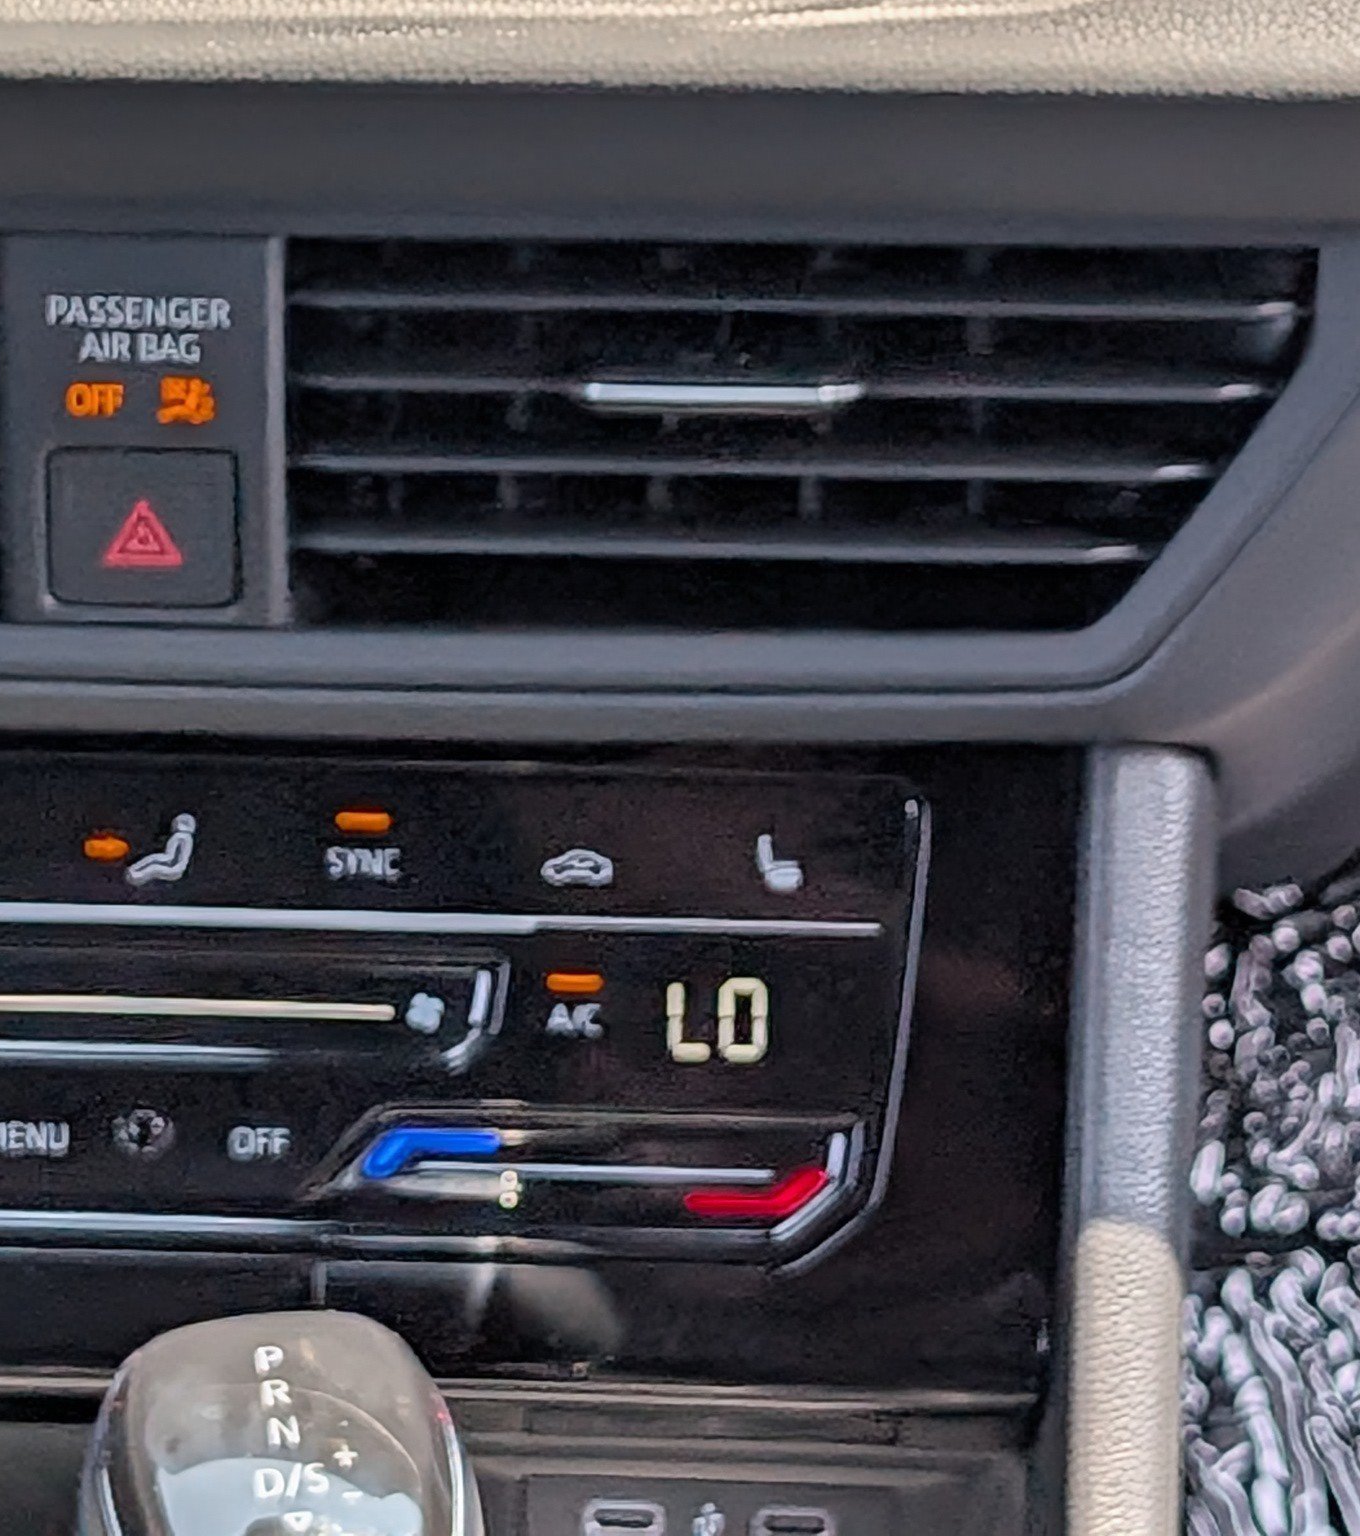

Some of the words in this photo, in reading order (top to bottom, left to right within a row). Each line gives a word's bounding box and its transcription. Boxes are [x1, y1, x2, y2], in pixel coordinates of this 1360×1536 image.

[46, 294, 231, 330] PASSENGER
[80, 332, 131, 362] AIR
[137, 333, 200, 363] BAG
[66, 382, 124, 416] OFF
[325, 846, 400, 880] SYNC
[667, 977, 768, 1063] LO
[227, 1125, 290, 1161] OFF
[254, 1345, 284, 1375] P
[260, 1379, 292, 1408] R
[267, 1415, 300, 1448] N
[253, 1462, 330, 1500] D/S
